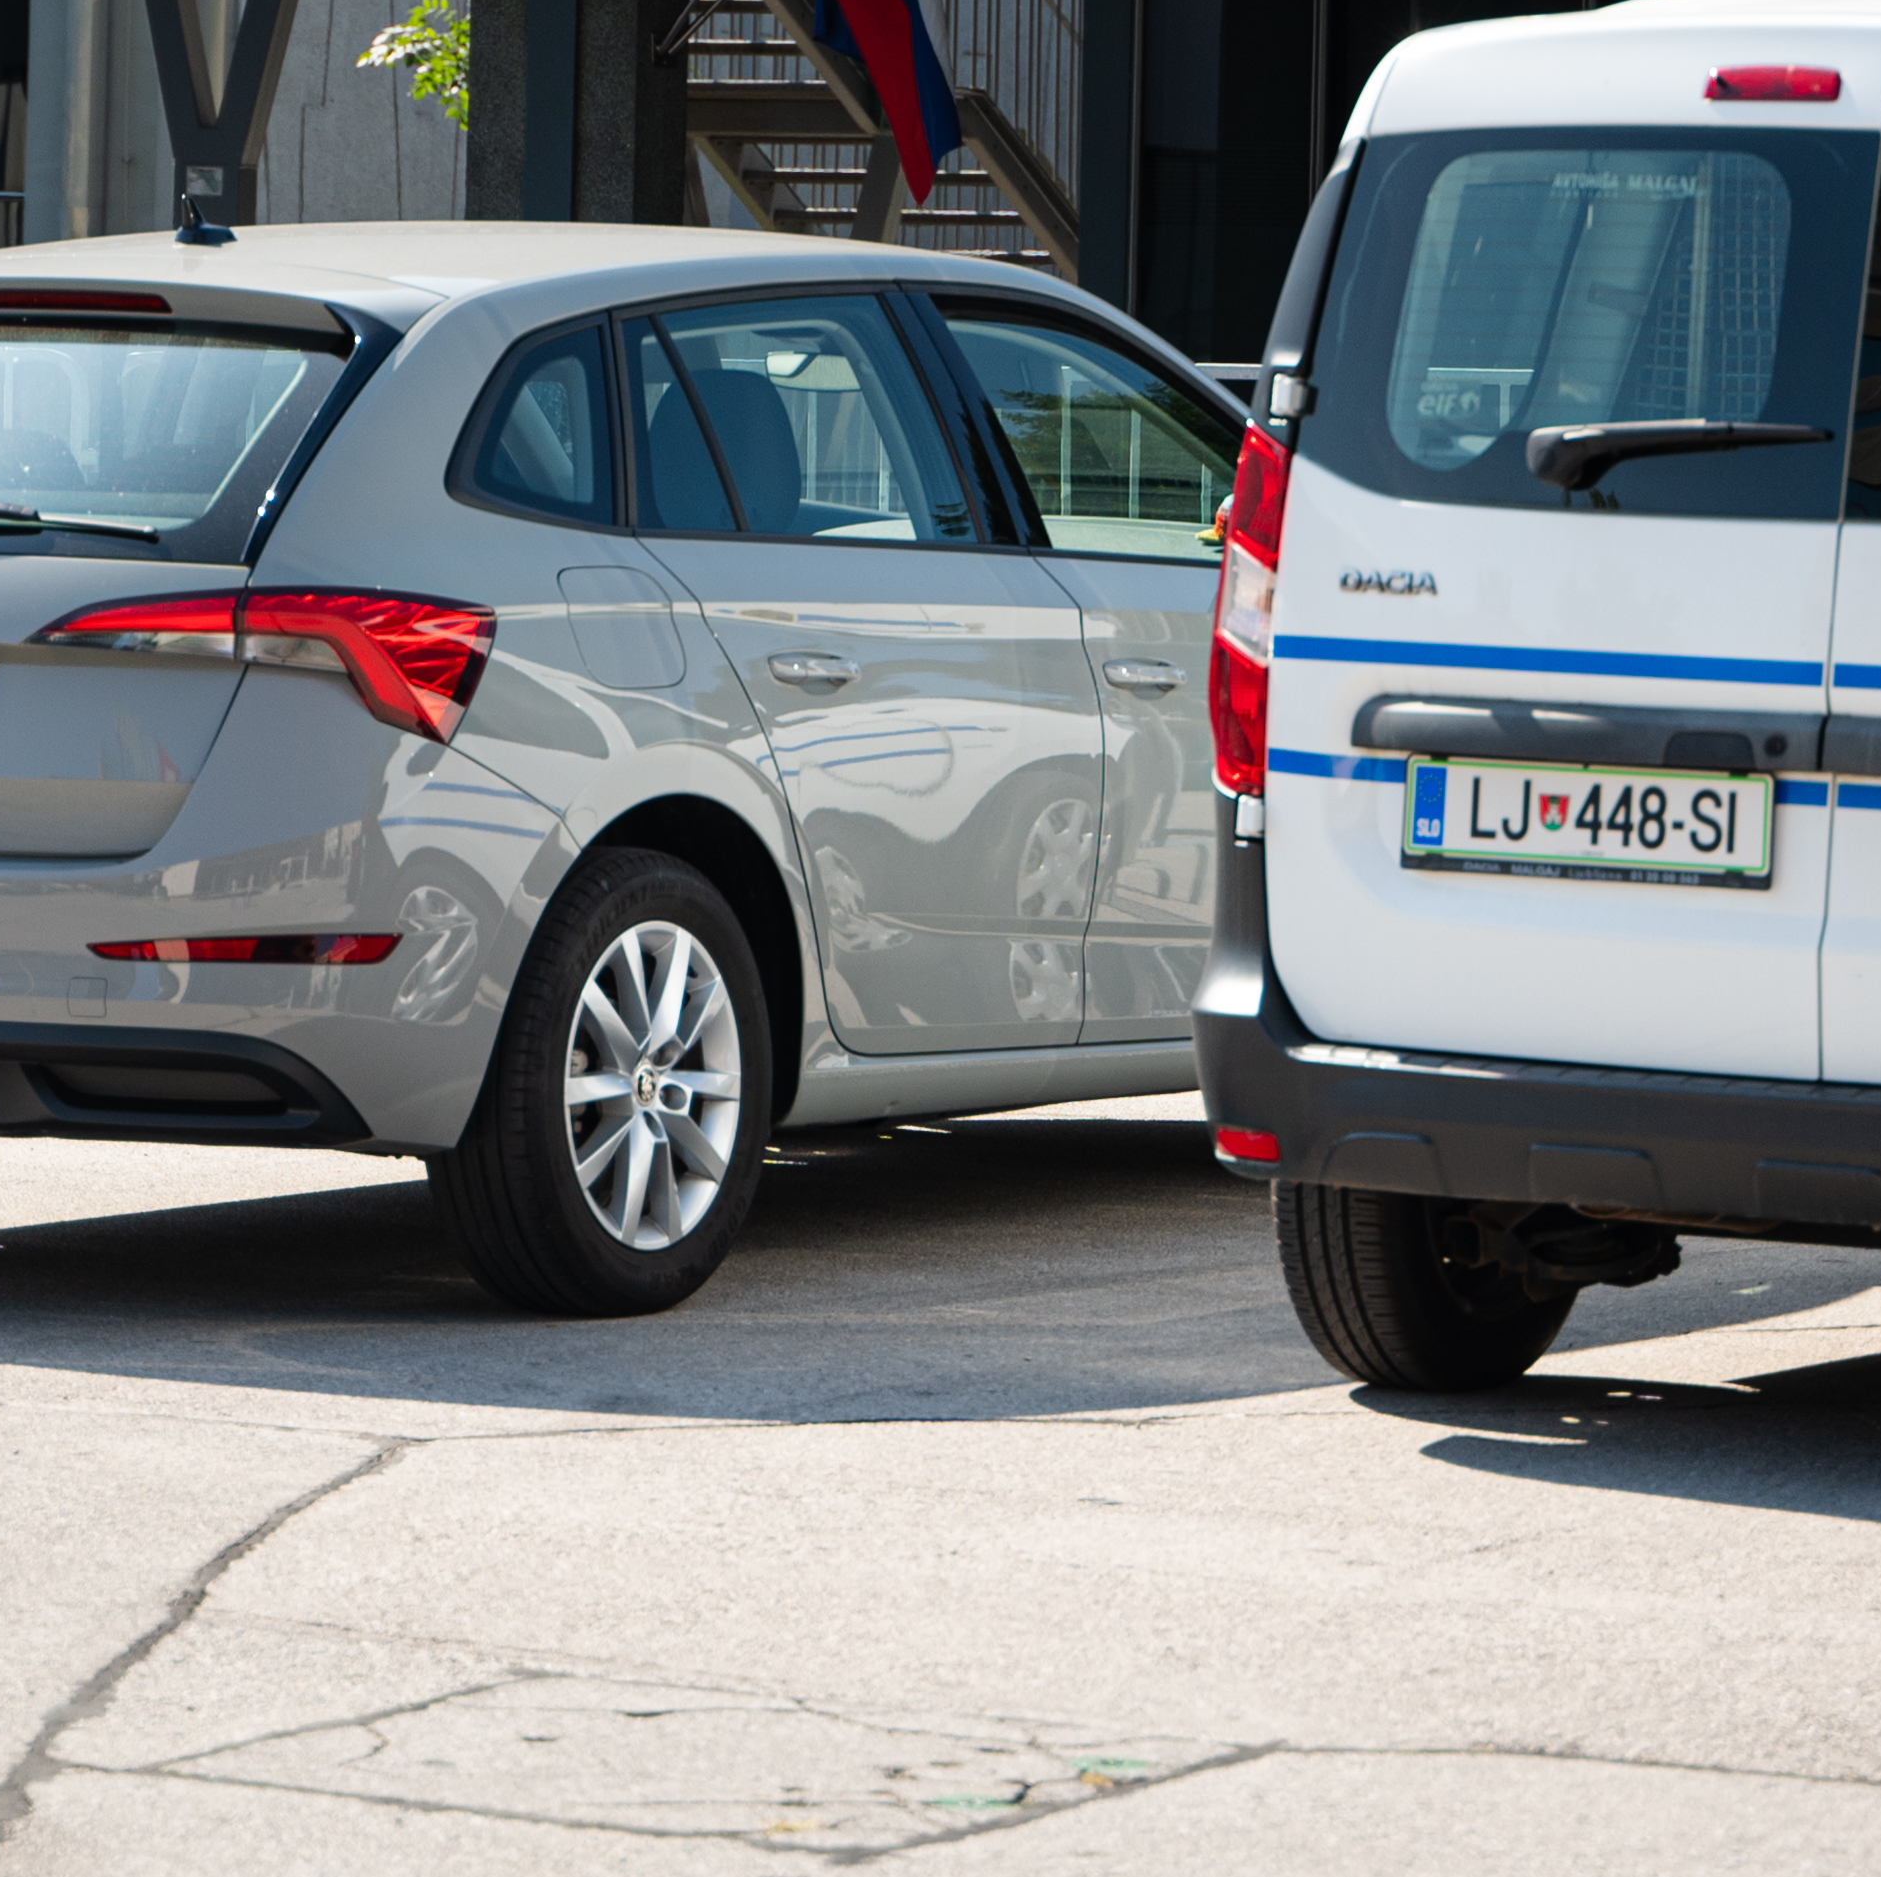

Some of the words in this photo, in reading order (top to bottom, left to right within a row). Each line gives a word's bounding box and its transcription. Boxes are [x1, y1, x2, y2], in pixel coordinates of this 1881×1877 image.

[1339, 568, 1438, 595] DACIA
[1416, 818, 1441, 838] SLO
[1469, 776, 1532, 841] LJ
[1574, 782, 1738, 854] 448-SI
